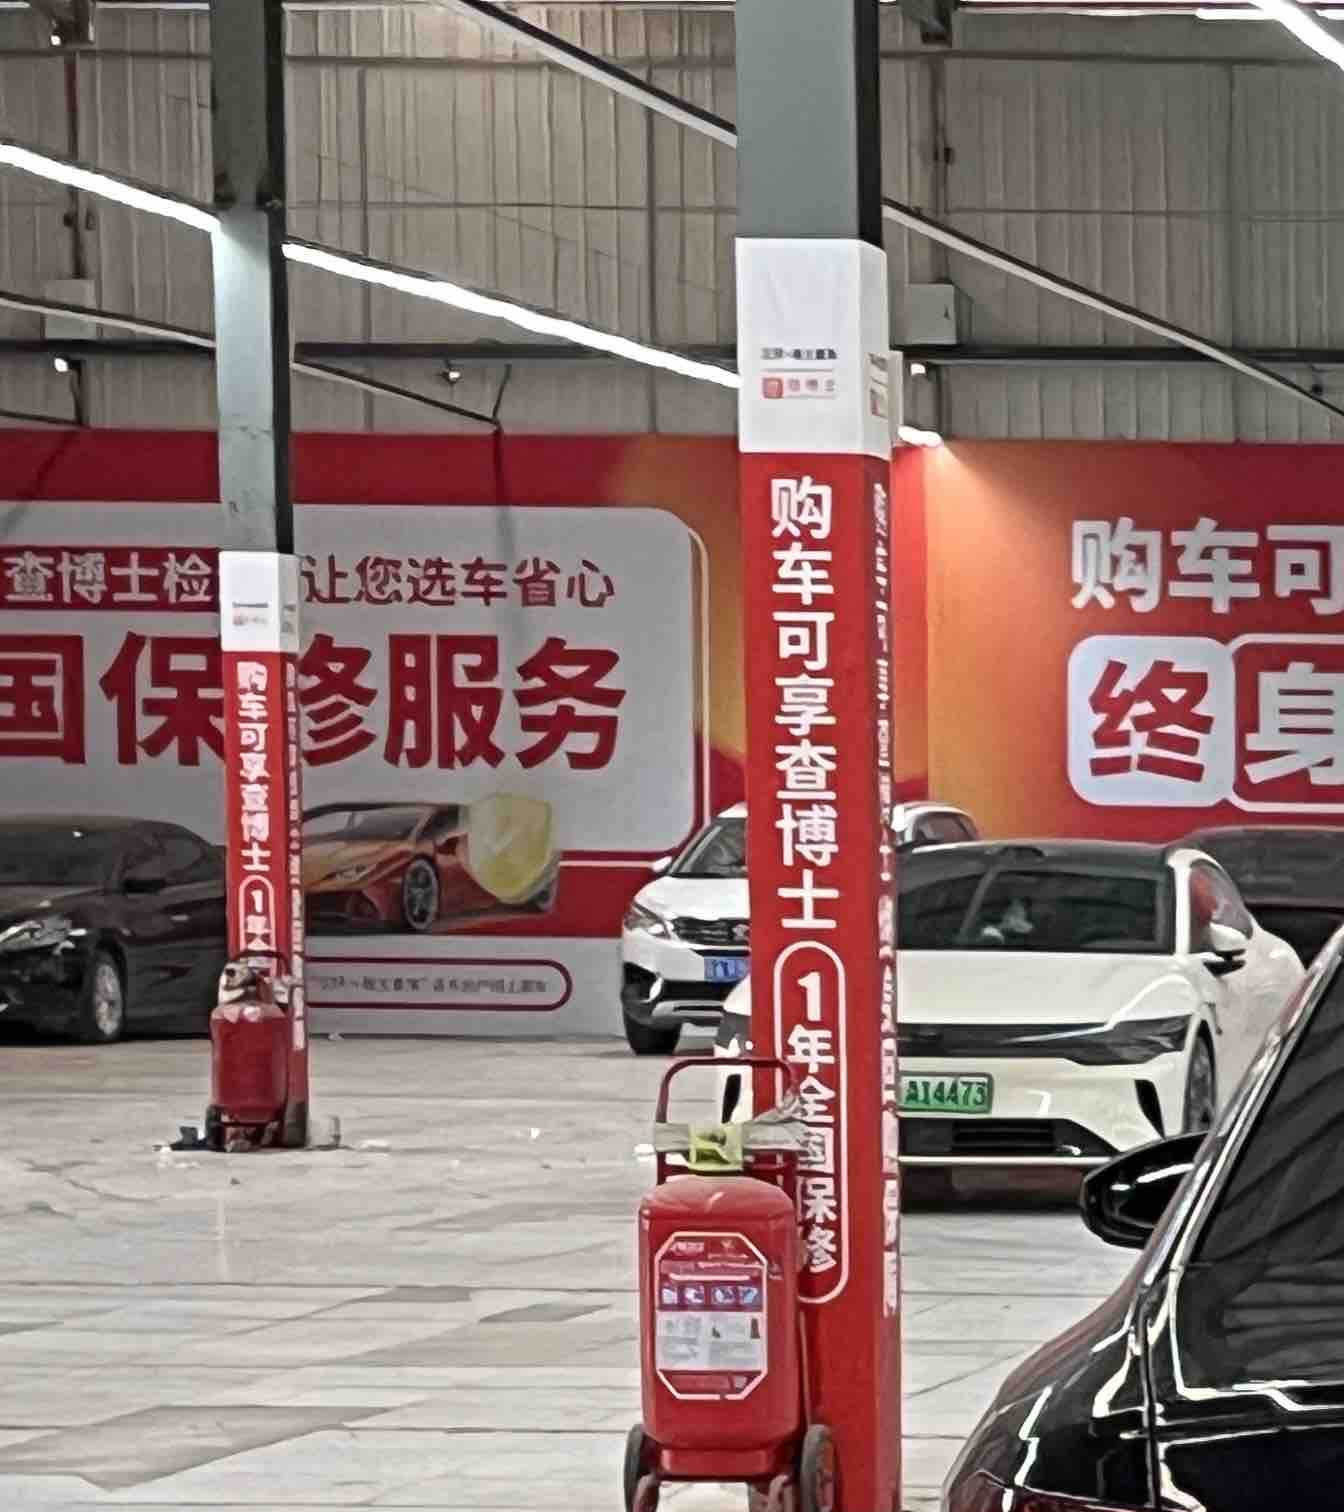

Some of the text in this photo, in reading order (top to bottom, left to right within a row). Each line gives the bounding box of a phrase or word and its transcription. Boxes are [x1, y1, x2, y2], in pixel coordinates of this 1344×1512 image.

[304, 554, 616, 608] 让您选车省心
[769, 475, 841, 931] 购车可享查博士
